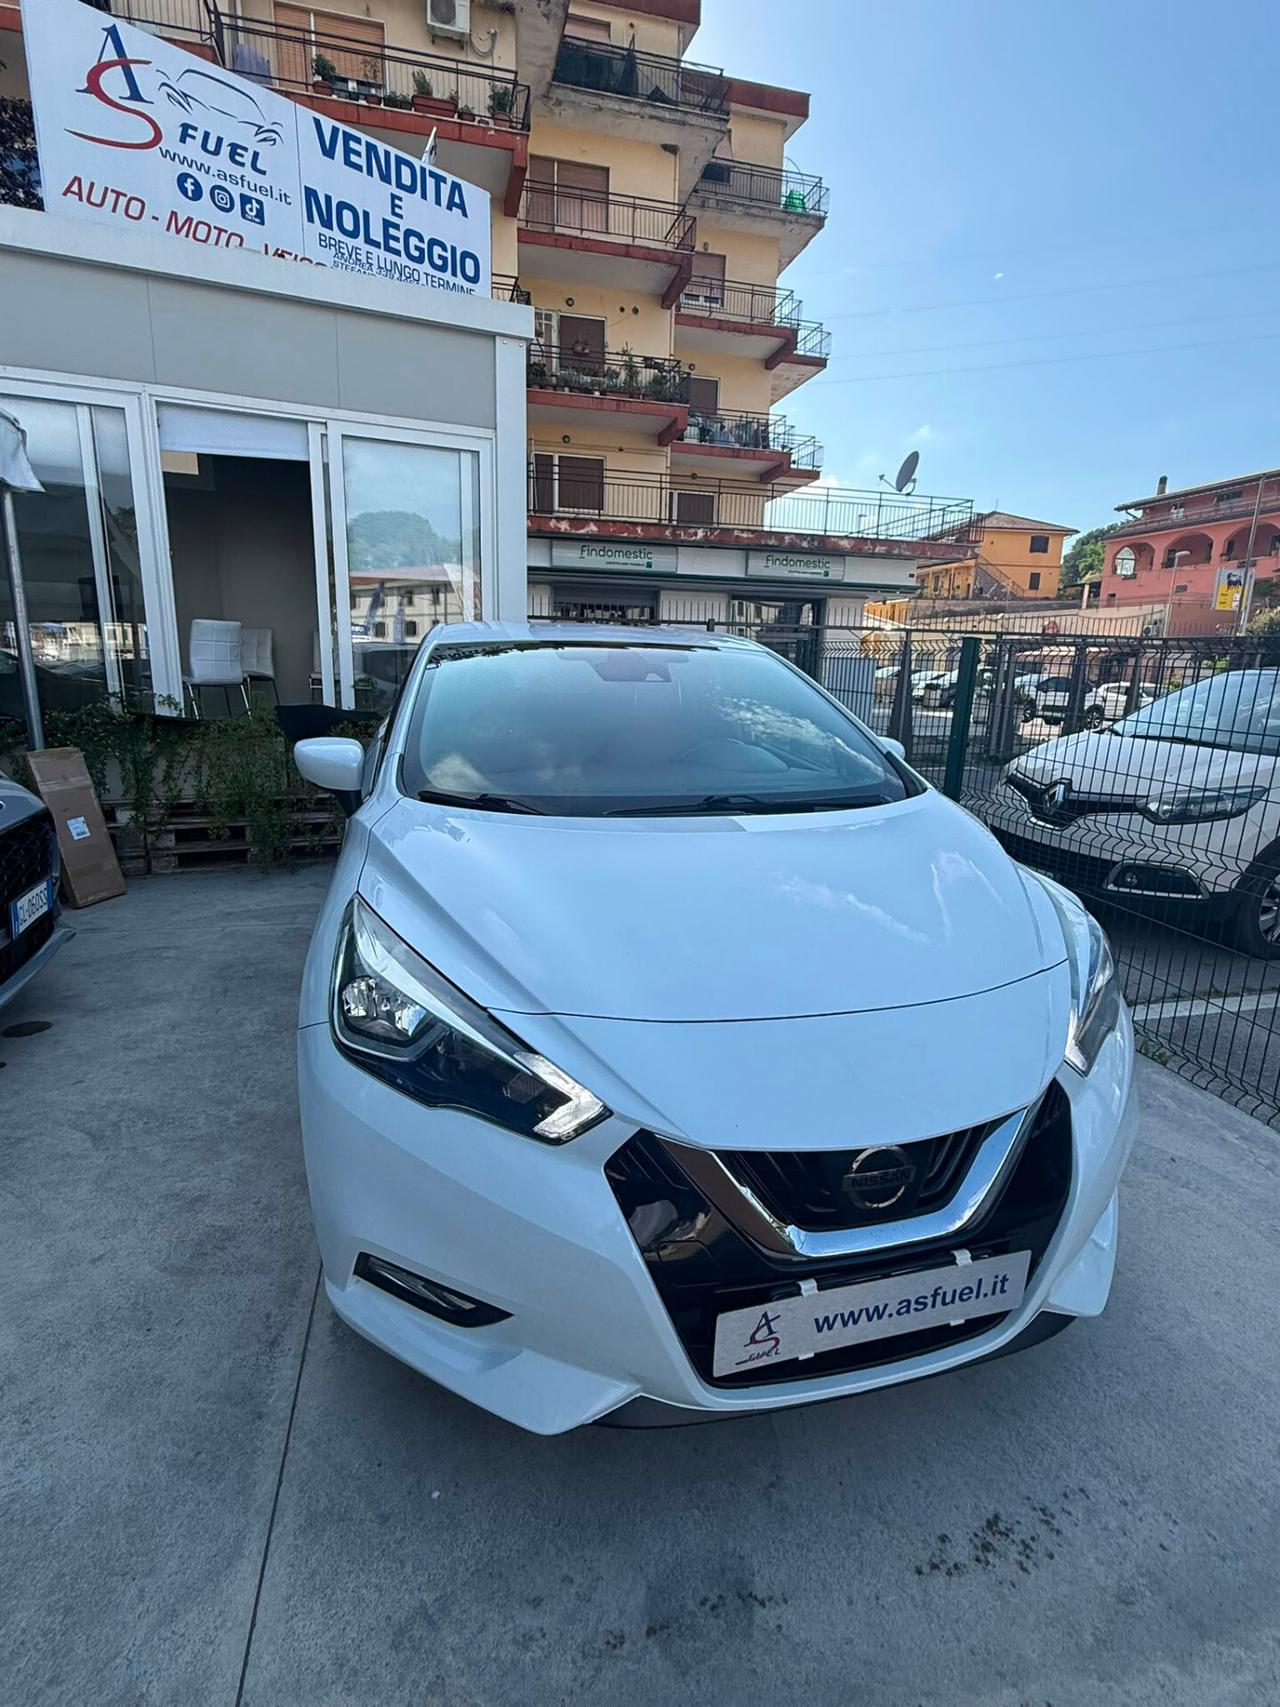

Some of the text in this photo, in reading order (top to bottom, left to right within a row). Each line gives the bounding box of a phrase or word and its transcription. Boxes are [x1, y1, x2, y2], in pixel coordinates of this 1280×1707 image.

[158, 146, 292, 206] www.asfuel.it
[179, 122, 267, 176] FUEL
[312, 116, 469, 219] VENDITA
[62, 175, 146, 221] AUTO
[166, 210, 245, 249] MOTO
[304, 185, 481, 285] NOLEGGIO
[390, 192, 404, 220] E
[318, 232, 362, 262] BREVE
[366, 250, 374, 266] E
[377, 255, 421, 282] LUNGO
[813, 1272, 1010, 1335] www.asfuel.it
